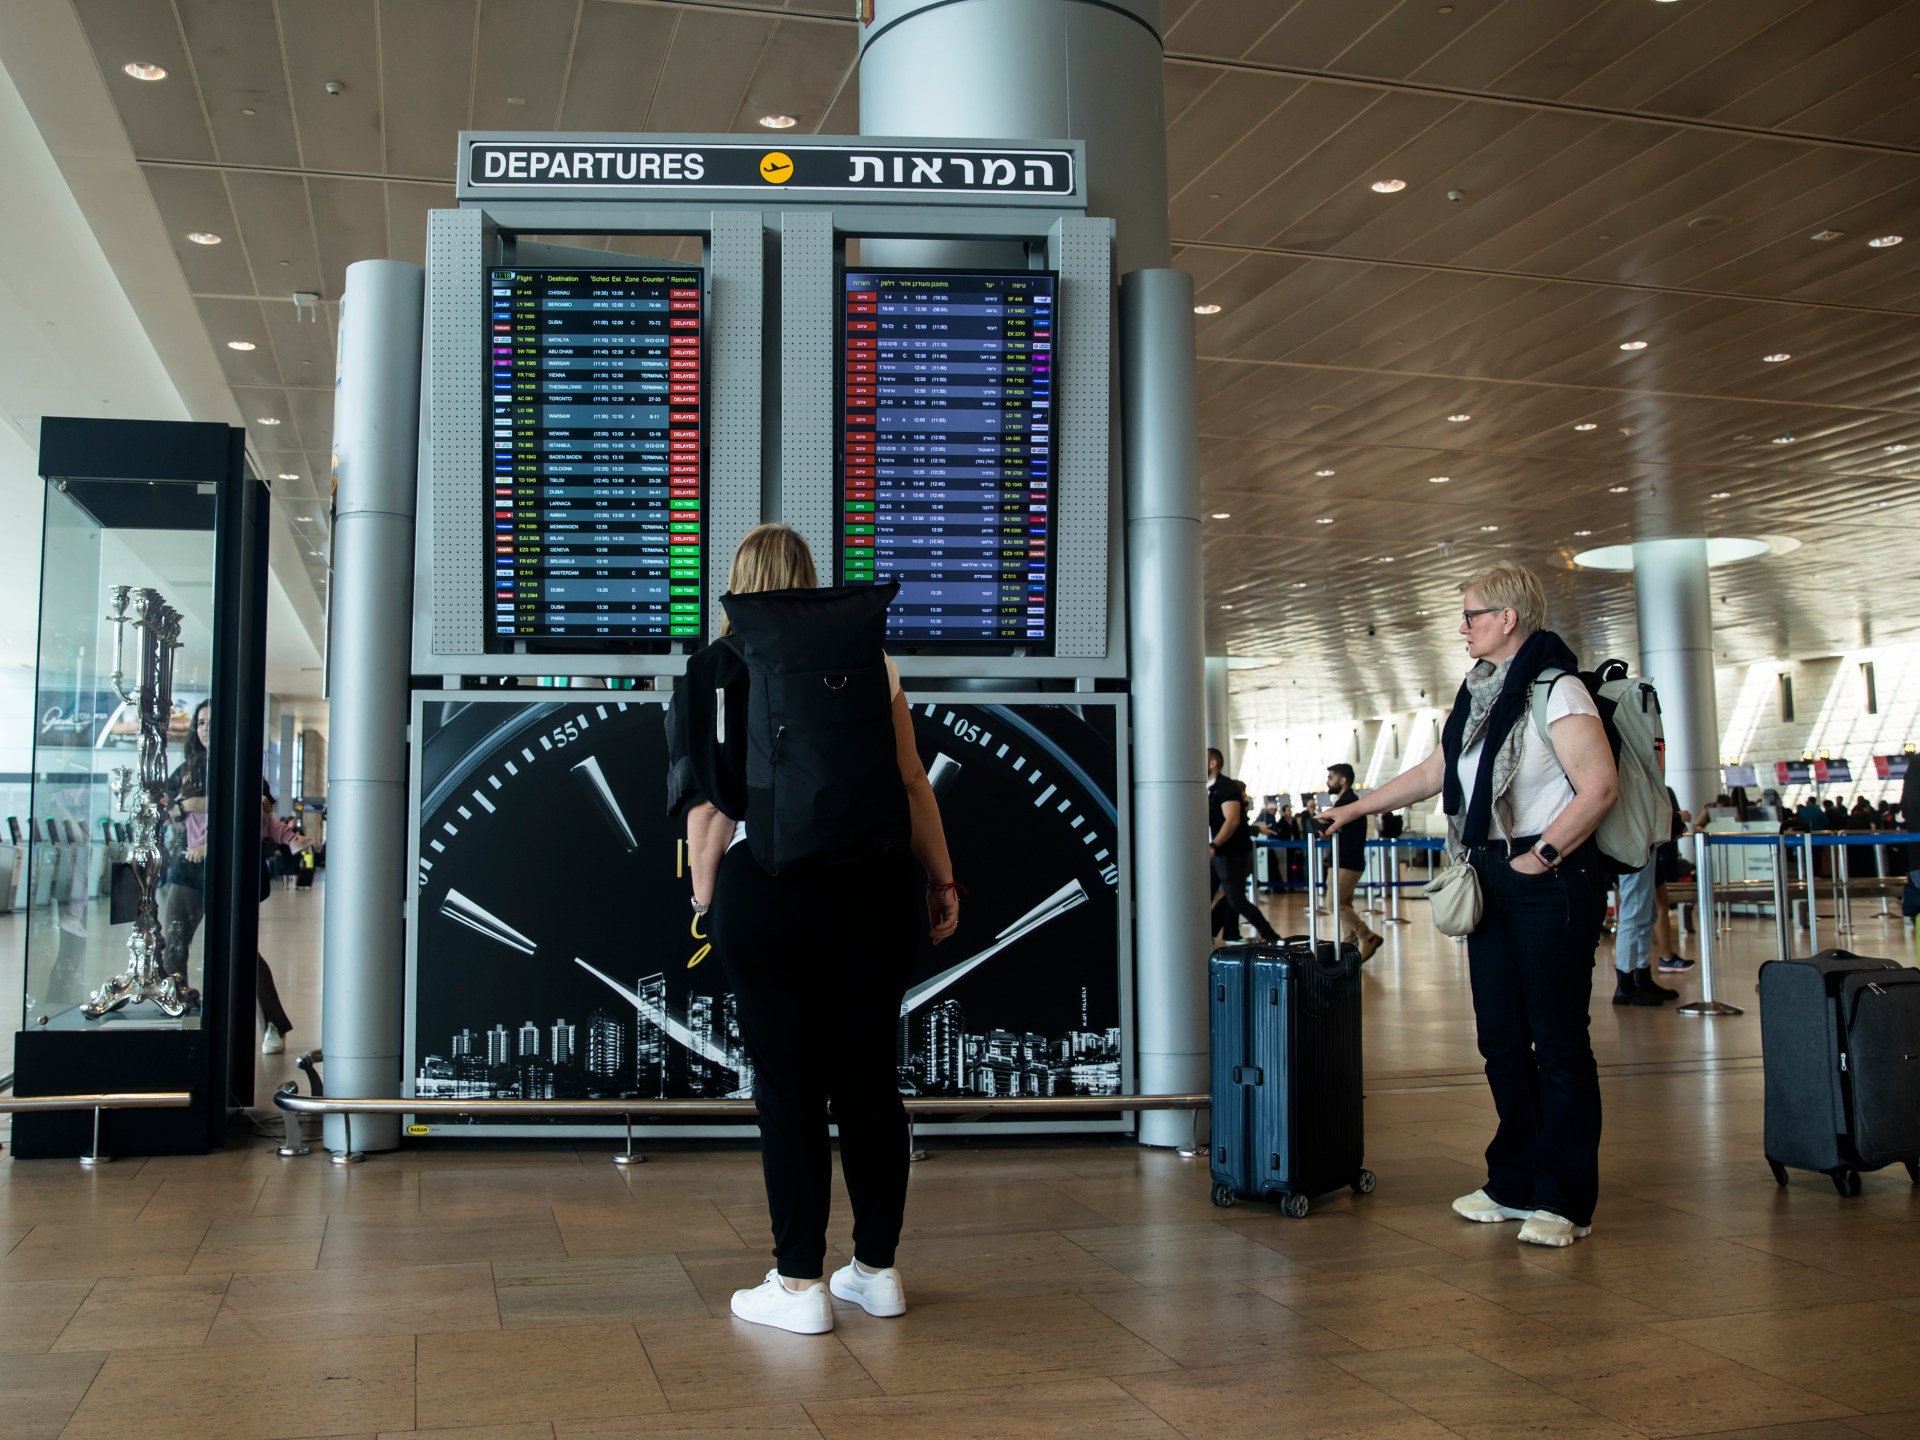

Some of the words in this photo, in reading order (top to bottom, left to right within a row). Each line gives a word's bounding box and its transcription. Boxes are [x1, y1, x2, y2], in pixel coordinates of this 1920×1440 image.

[484, 152, 705, 180] DEPARTURES
[849, 154, 1054, 186] המראות
[553, 720, 579, 748] 55
[954, 719, 982, 742] 05
[1099, 862, 1118, 885] 10
